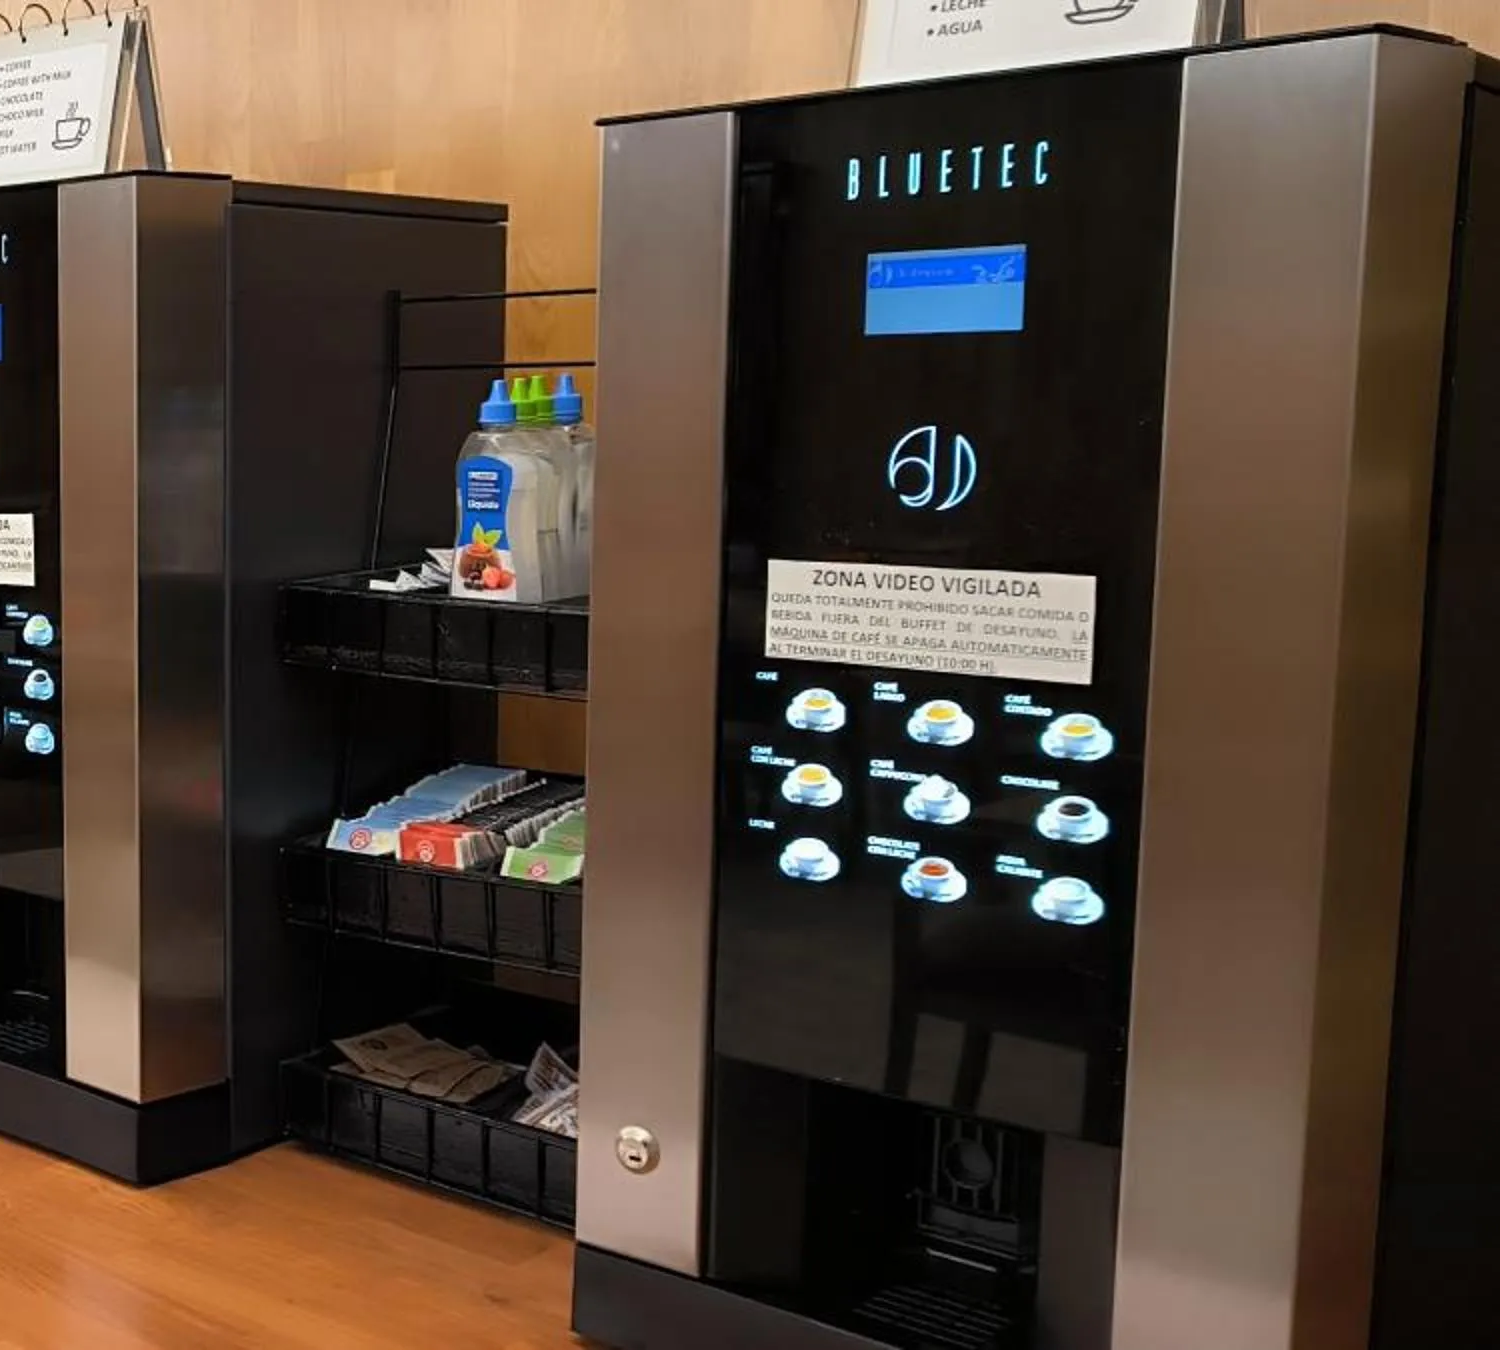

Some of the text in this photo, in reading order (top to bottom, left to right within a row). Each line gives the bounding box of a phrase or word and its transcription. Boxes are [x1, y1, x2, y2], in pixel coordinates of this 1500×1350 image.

[938, 19, 983, 36] AGUA
[5, 60, 31, 72] COFFEE
[3, 70, 71, 88] COFFEE WITH MILK
[1, 91, 43, 106] CHOCOLATE
[25, 107, 44, 117] MILK
[11, 142, 37, 153] WATER
[847, 140, 1050, 200] BLUETEC
[812, 569, 1042, 598] ZONA VIDEO VIGILADA
[771, 593, 1089, 623] QUEDA TOTALMENTE PROHIBIDO SACAR COMIDA O
[771, 609, 812, 621] BEBIDA
[821, 613, 860, 625] FUERA
[869, 616, 890, 628] DEL
[901, 617, 946, 631] BUFFET
[956, 621, 972, 633] DE
[1072, 629, 1088, 642] LA
[832, 630, 847, 642] DE
[885, 635, 897, 645] SE
[903, 635, 947, 649] APAGA
[770, 643, 781, 653] AL
[786, 643, 846, 658] TERMINAR
[851, 650, 862, 661] EL
[866, 651, 934, 667] DESAYUNO
